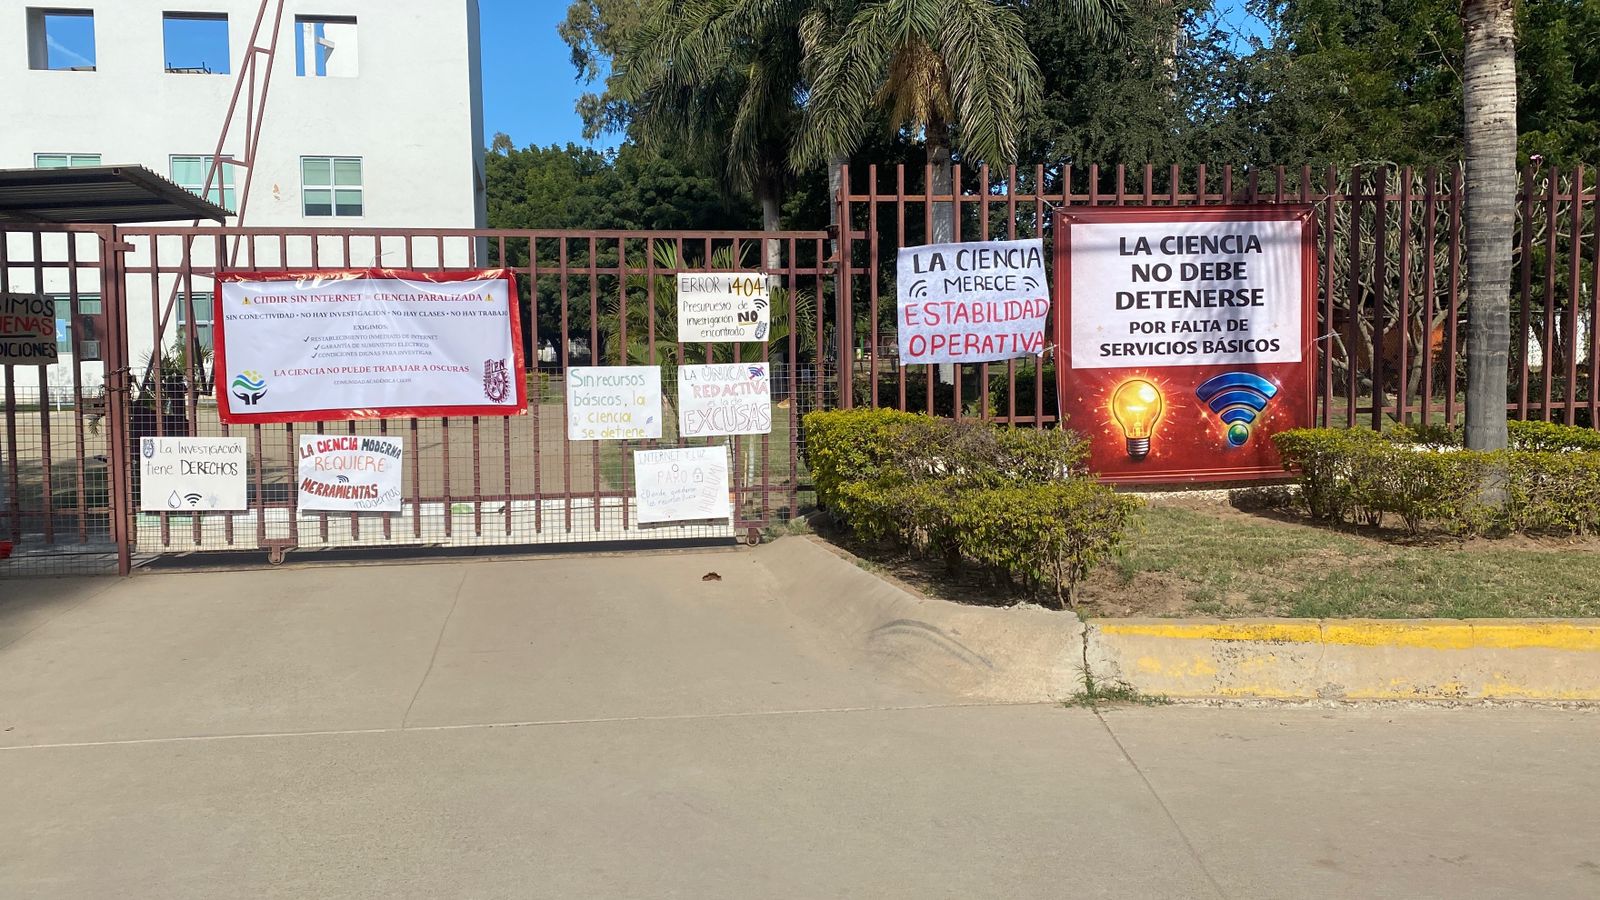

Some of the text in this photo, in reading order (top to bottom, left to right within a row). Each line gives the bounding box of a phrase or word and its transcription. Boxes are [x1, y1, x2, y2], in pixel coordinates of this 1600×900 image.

[1119, 235, 1262, 256] LA CIENCIA
[913, 247, 1041, 274] LA CIENCIA
[1132, 262, 1247, 282] NO DEBE
[681, 277, 768, 297] ERROR ¡404!
[944, 275, 1016, 294] MERECE
[291, 295, 307, 303] SIN
[310, 294, 361, 302] INTERNET
[683, 300, 748, 312] Presupuesto de
[1116, 289, 1264, 310] DETENERSE
[0, 298, 53, 317] IMOS
[738, 310, 758, 322] NO
[905, 299, 1050, 326] ESTABILIDAD
[701, 327, 745, 337] encontrado
[1130, 319, 1248, 334] POR FALTA DE
[909, 331, 1045, 357] OPERATIVA
[1100, 338, 1280, 357] SERVICIOS BÁSICOS
[288, 368, 326, 376] CIENCIA
[570, 369, 645, 387] Sin recursos
[684, 365, 747, 381] LA ÚNICA
[633, 390, 646, 406] la
[588, 411, 632, 423] ciencia
[684, 403, 771, 435] EXCUSAS
[582, 428, 595, 438] se
[160, 440, 172, 454] La
[300, 437, 401, 459] LA CIENCIA MODERNA
[181, 460, 238, 476] DERECHOS
[314, 456, 386, 472] REQUIERE
